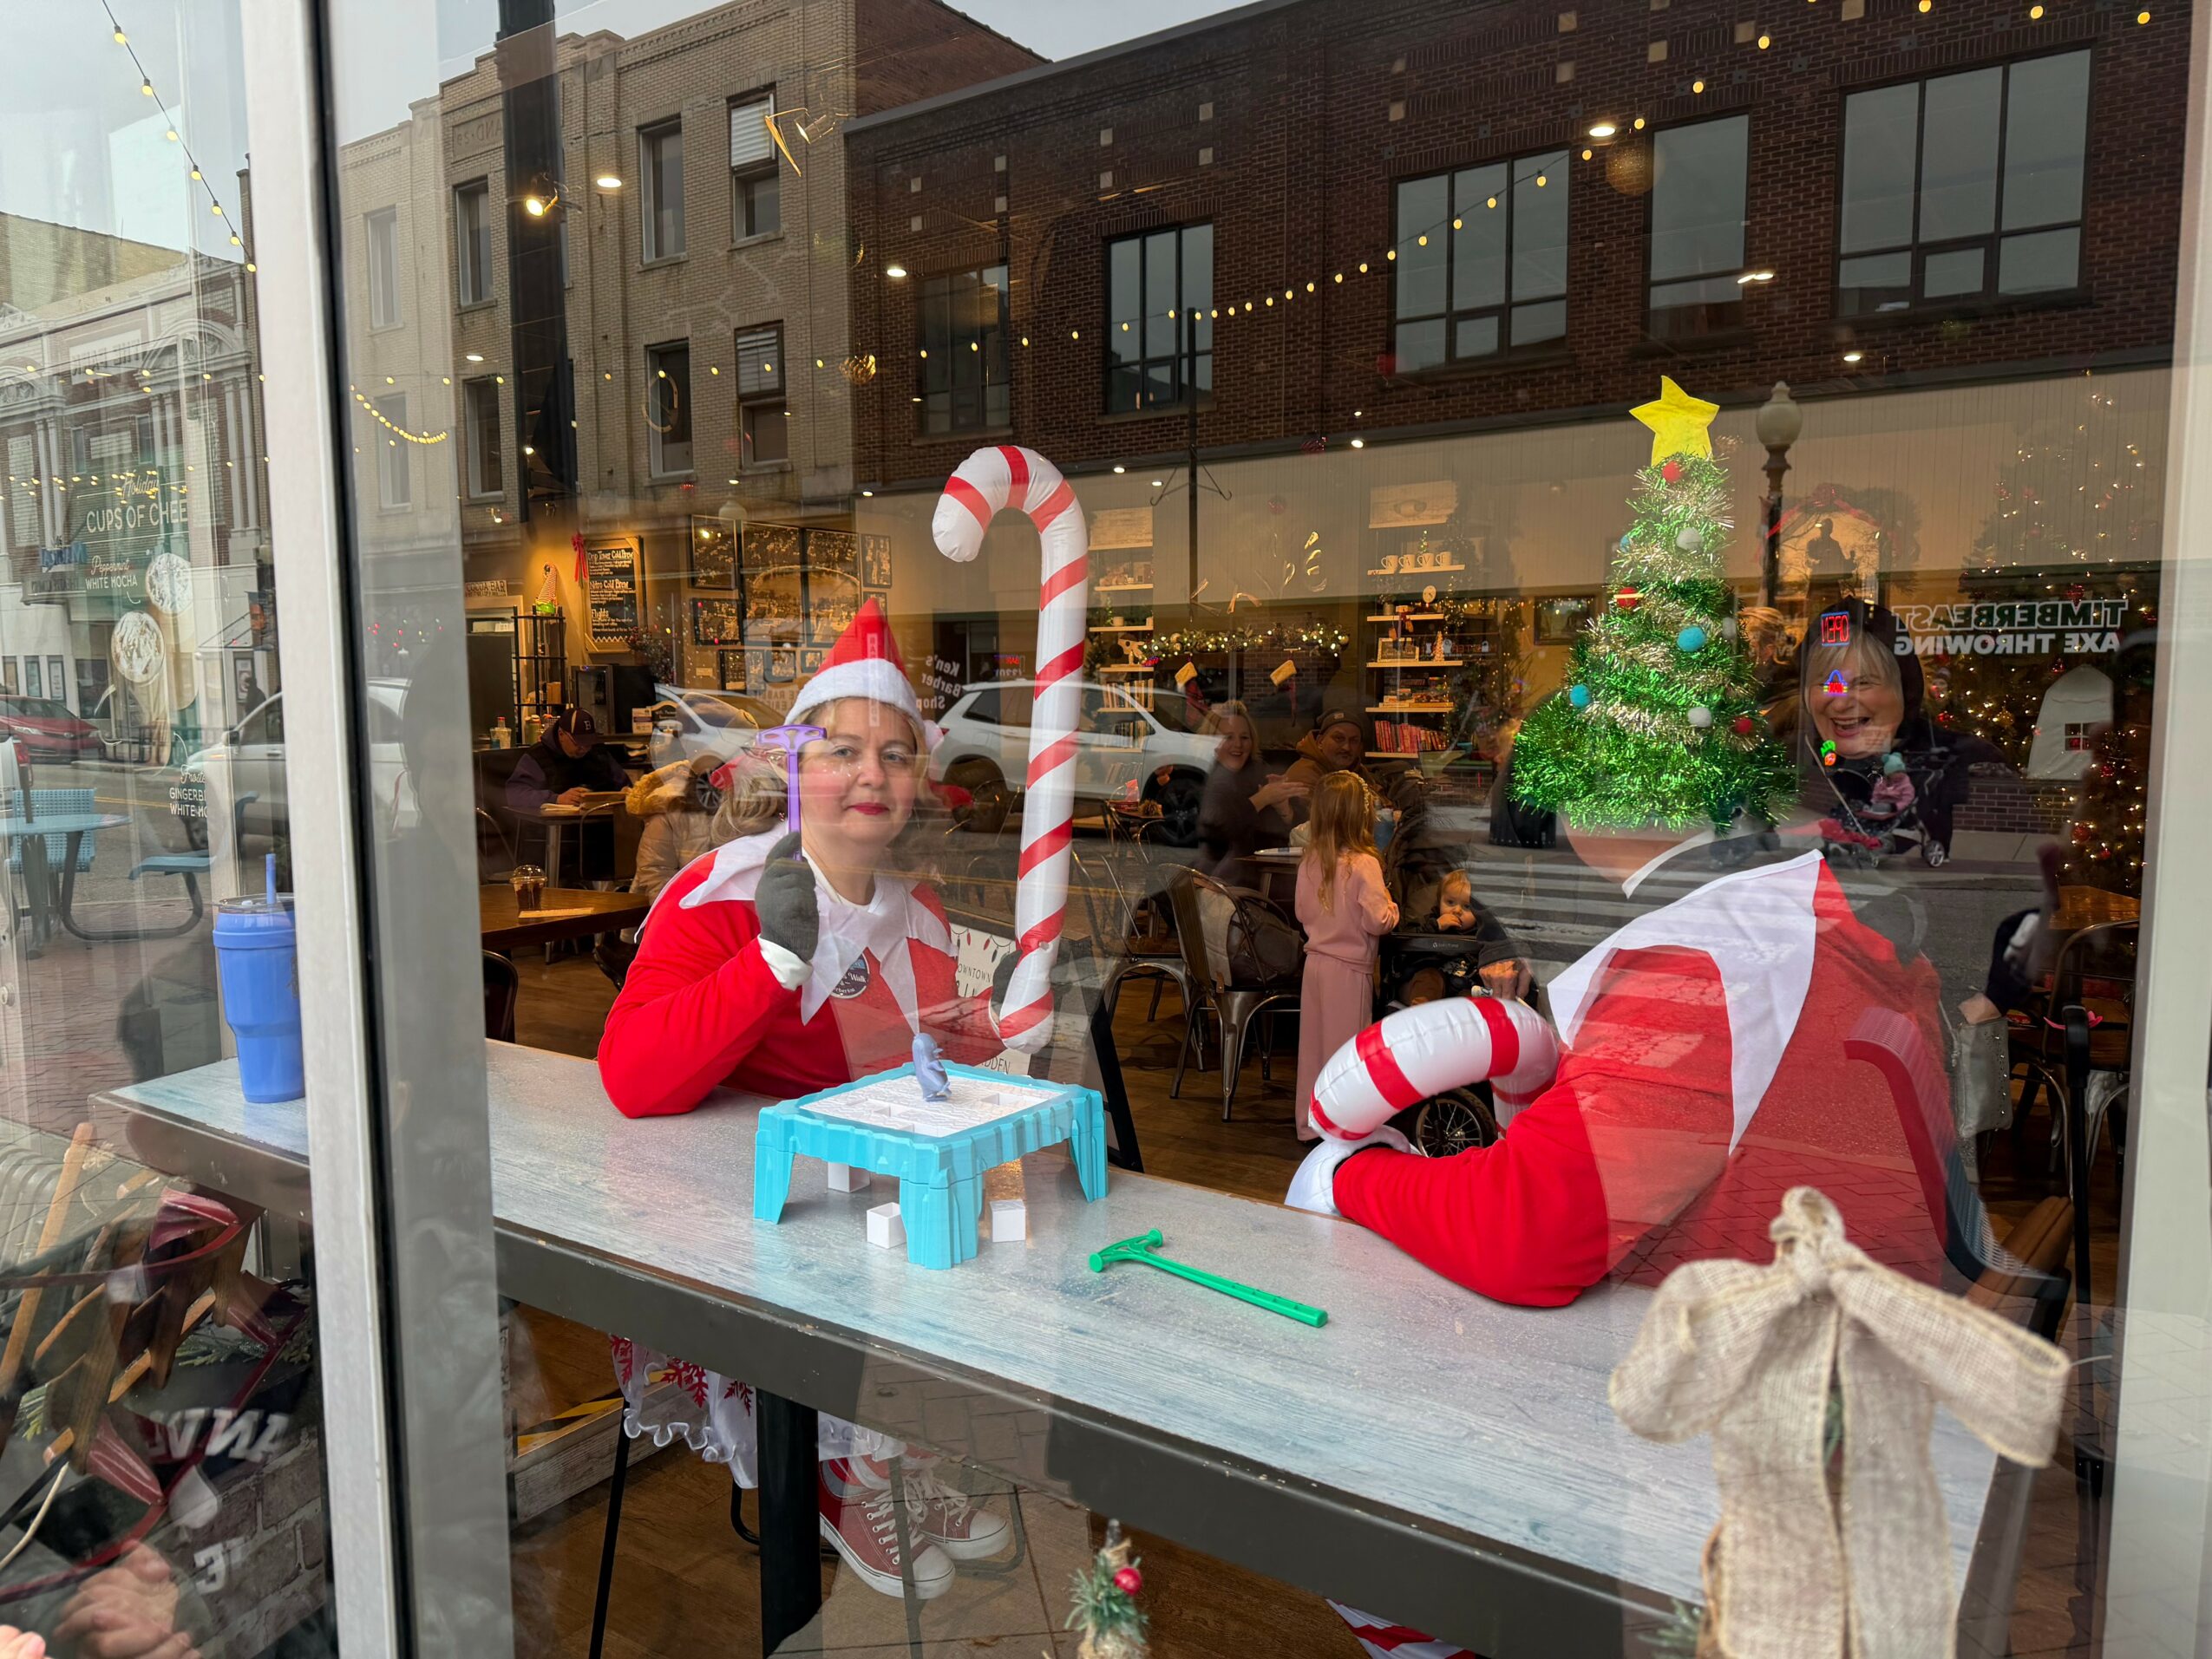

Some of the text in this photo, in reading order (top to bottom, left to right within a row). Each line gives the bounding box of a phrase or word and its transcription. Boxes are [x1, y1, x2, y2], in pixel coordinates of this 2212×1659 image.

[123, 469, 160, 498] Holiday
[87, 499, 188, 532] CUPS OF CHEE
[611, 550, 622, 559] Cold
[91, 555, 131, 576] Peppermint
[85, 577, 109, 590] WHITE
[111, 575, 138, 588] MOCHA
[603, 579, 615, 589] Cold
[614, 578, 629, 589] Brew
[180, 764, 207, 784] Froste
[169, 803, 196, 817] WHITE
[957, 963, 991, 983] OWNTOWN
